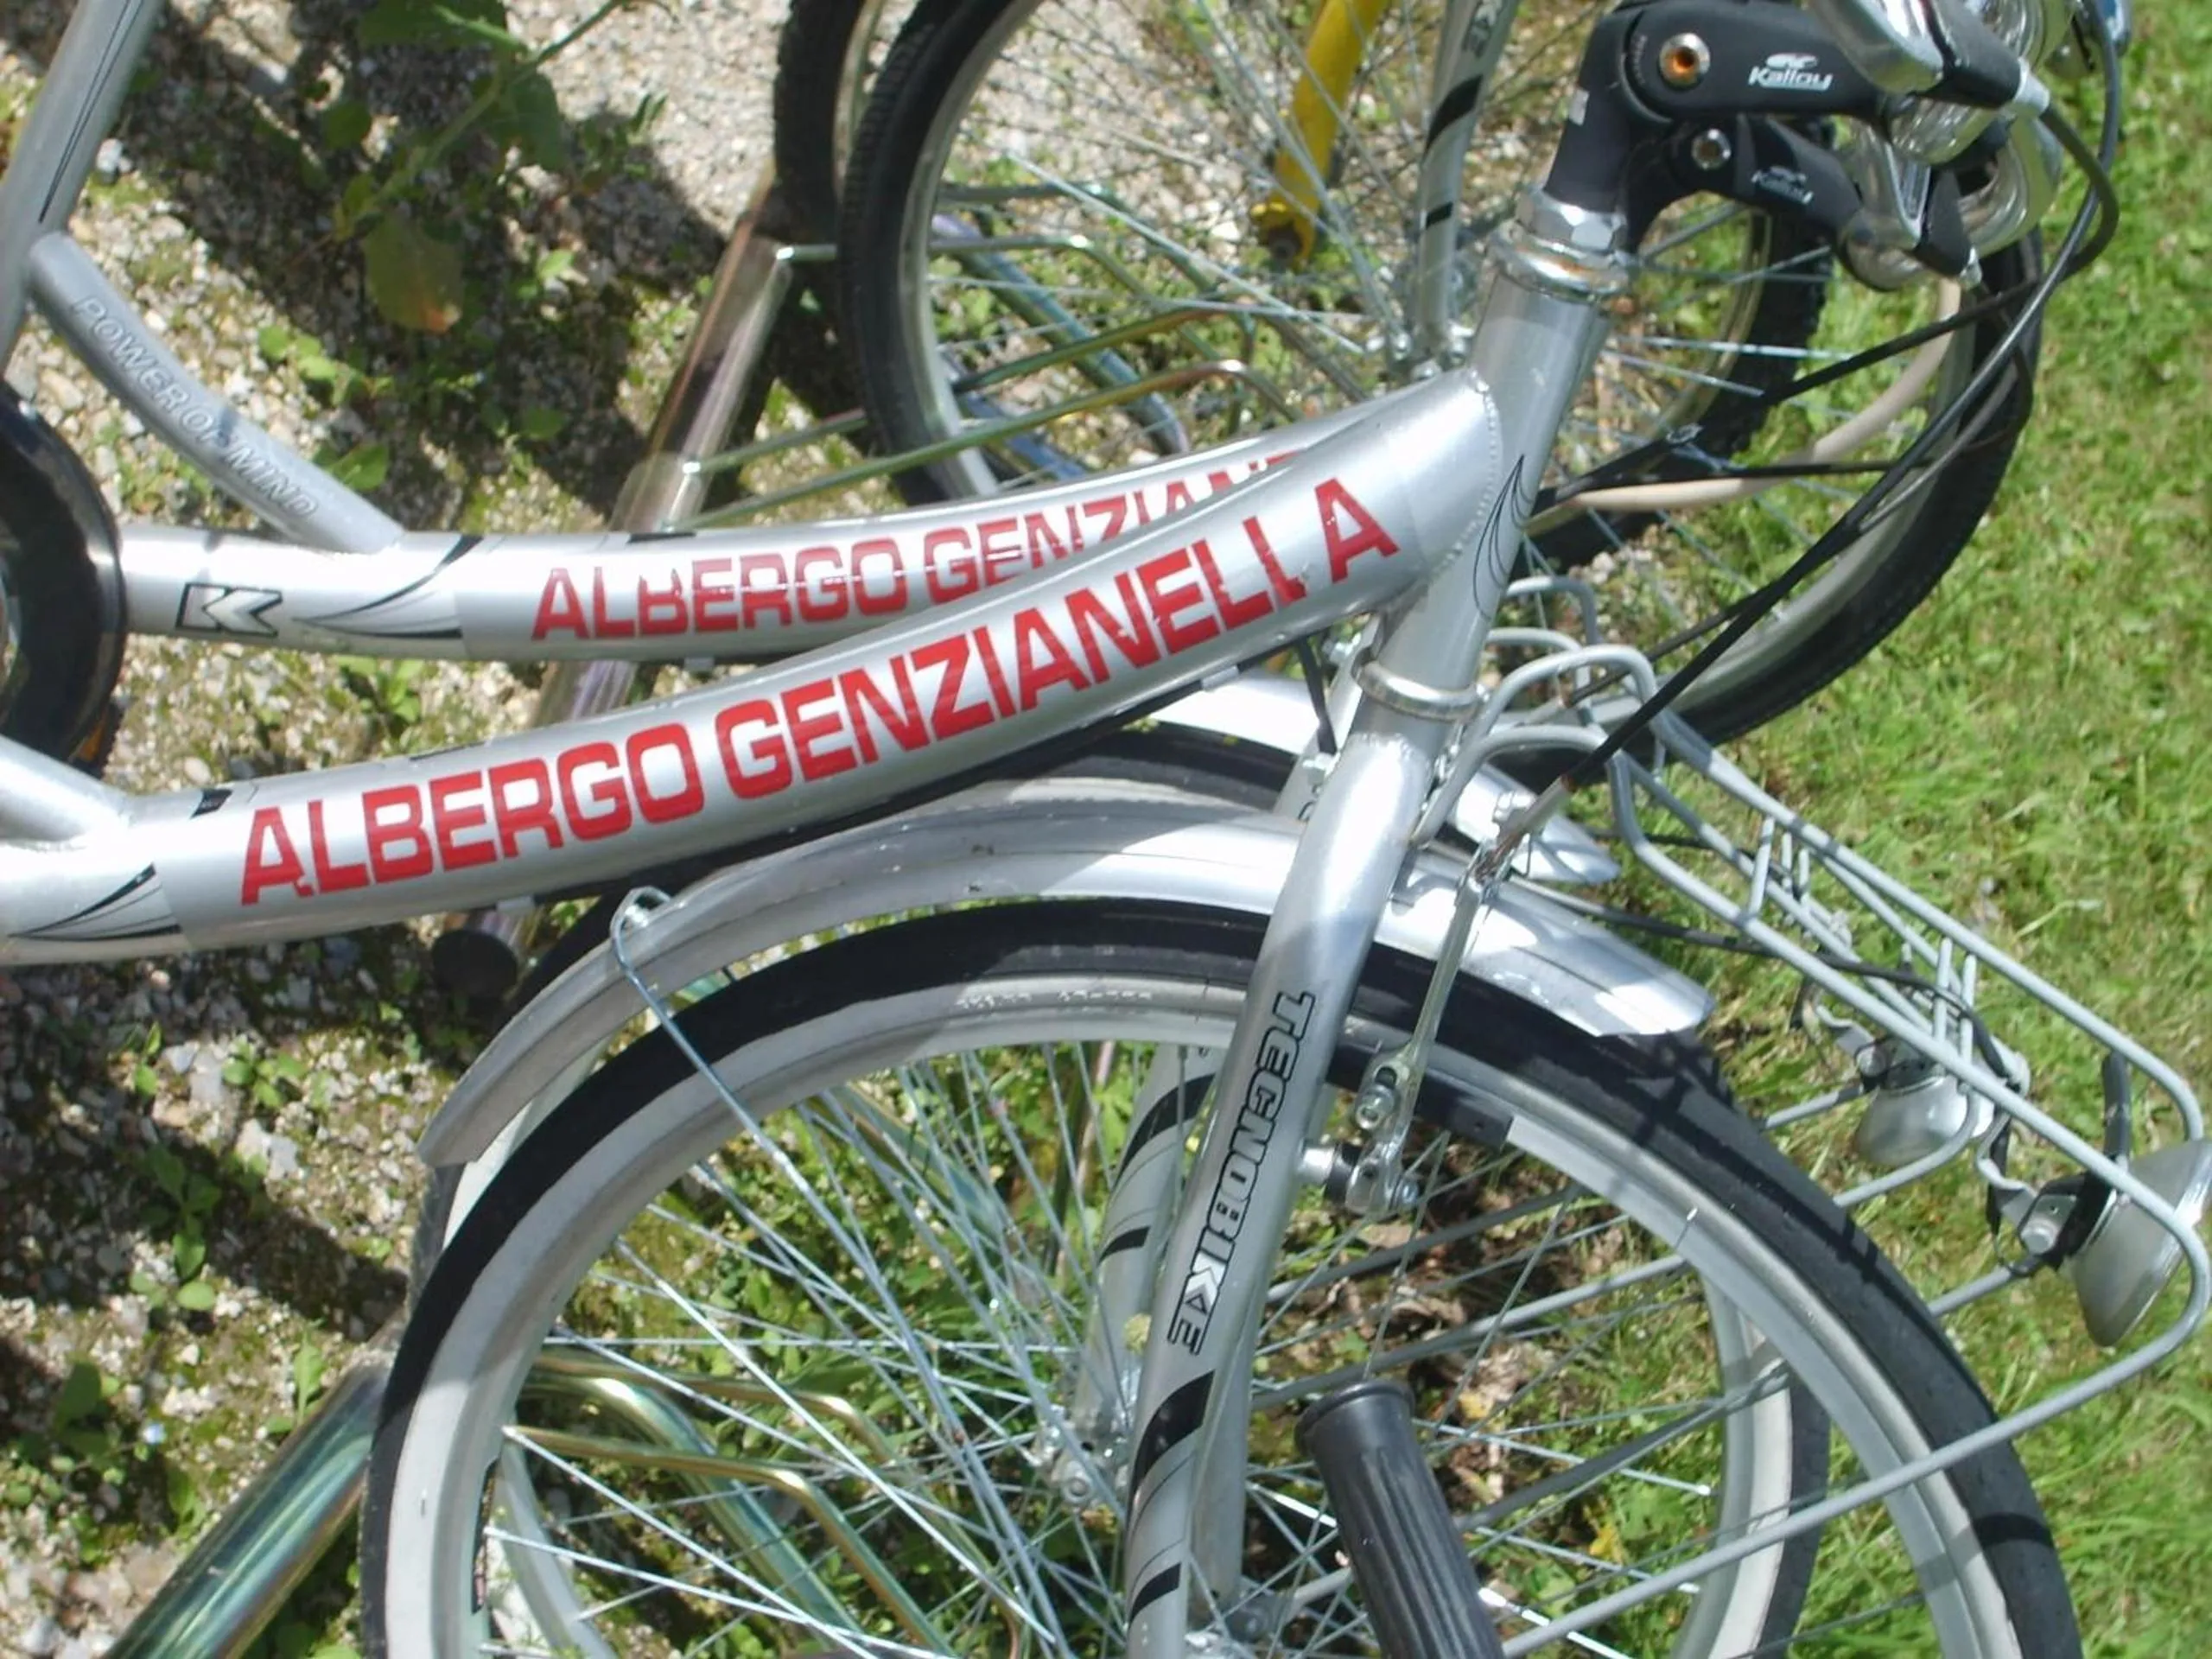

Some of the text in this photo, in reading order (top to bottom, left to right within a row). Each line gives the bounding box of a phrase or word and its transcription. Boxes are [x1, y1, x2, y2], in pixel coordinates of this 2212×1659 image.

[242, 477, 1402, 905] ALBERGO GENZIANELLA
[531, 536, 909, 640] ALBERGO
[1167, 990, 1316, 1356] TECNOBIKE
